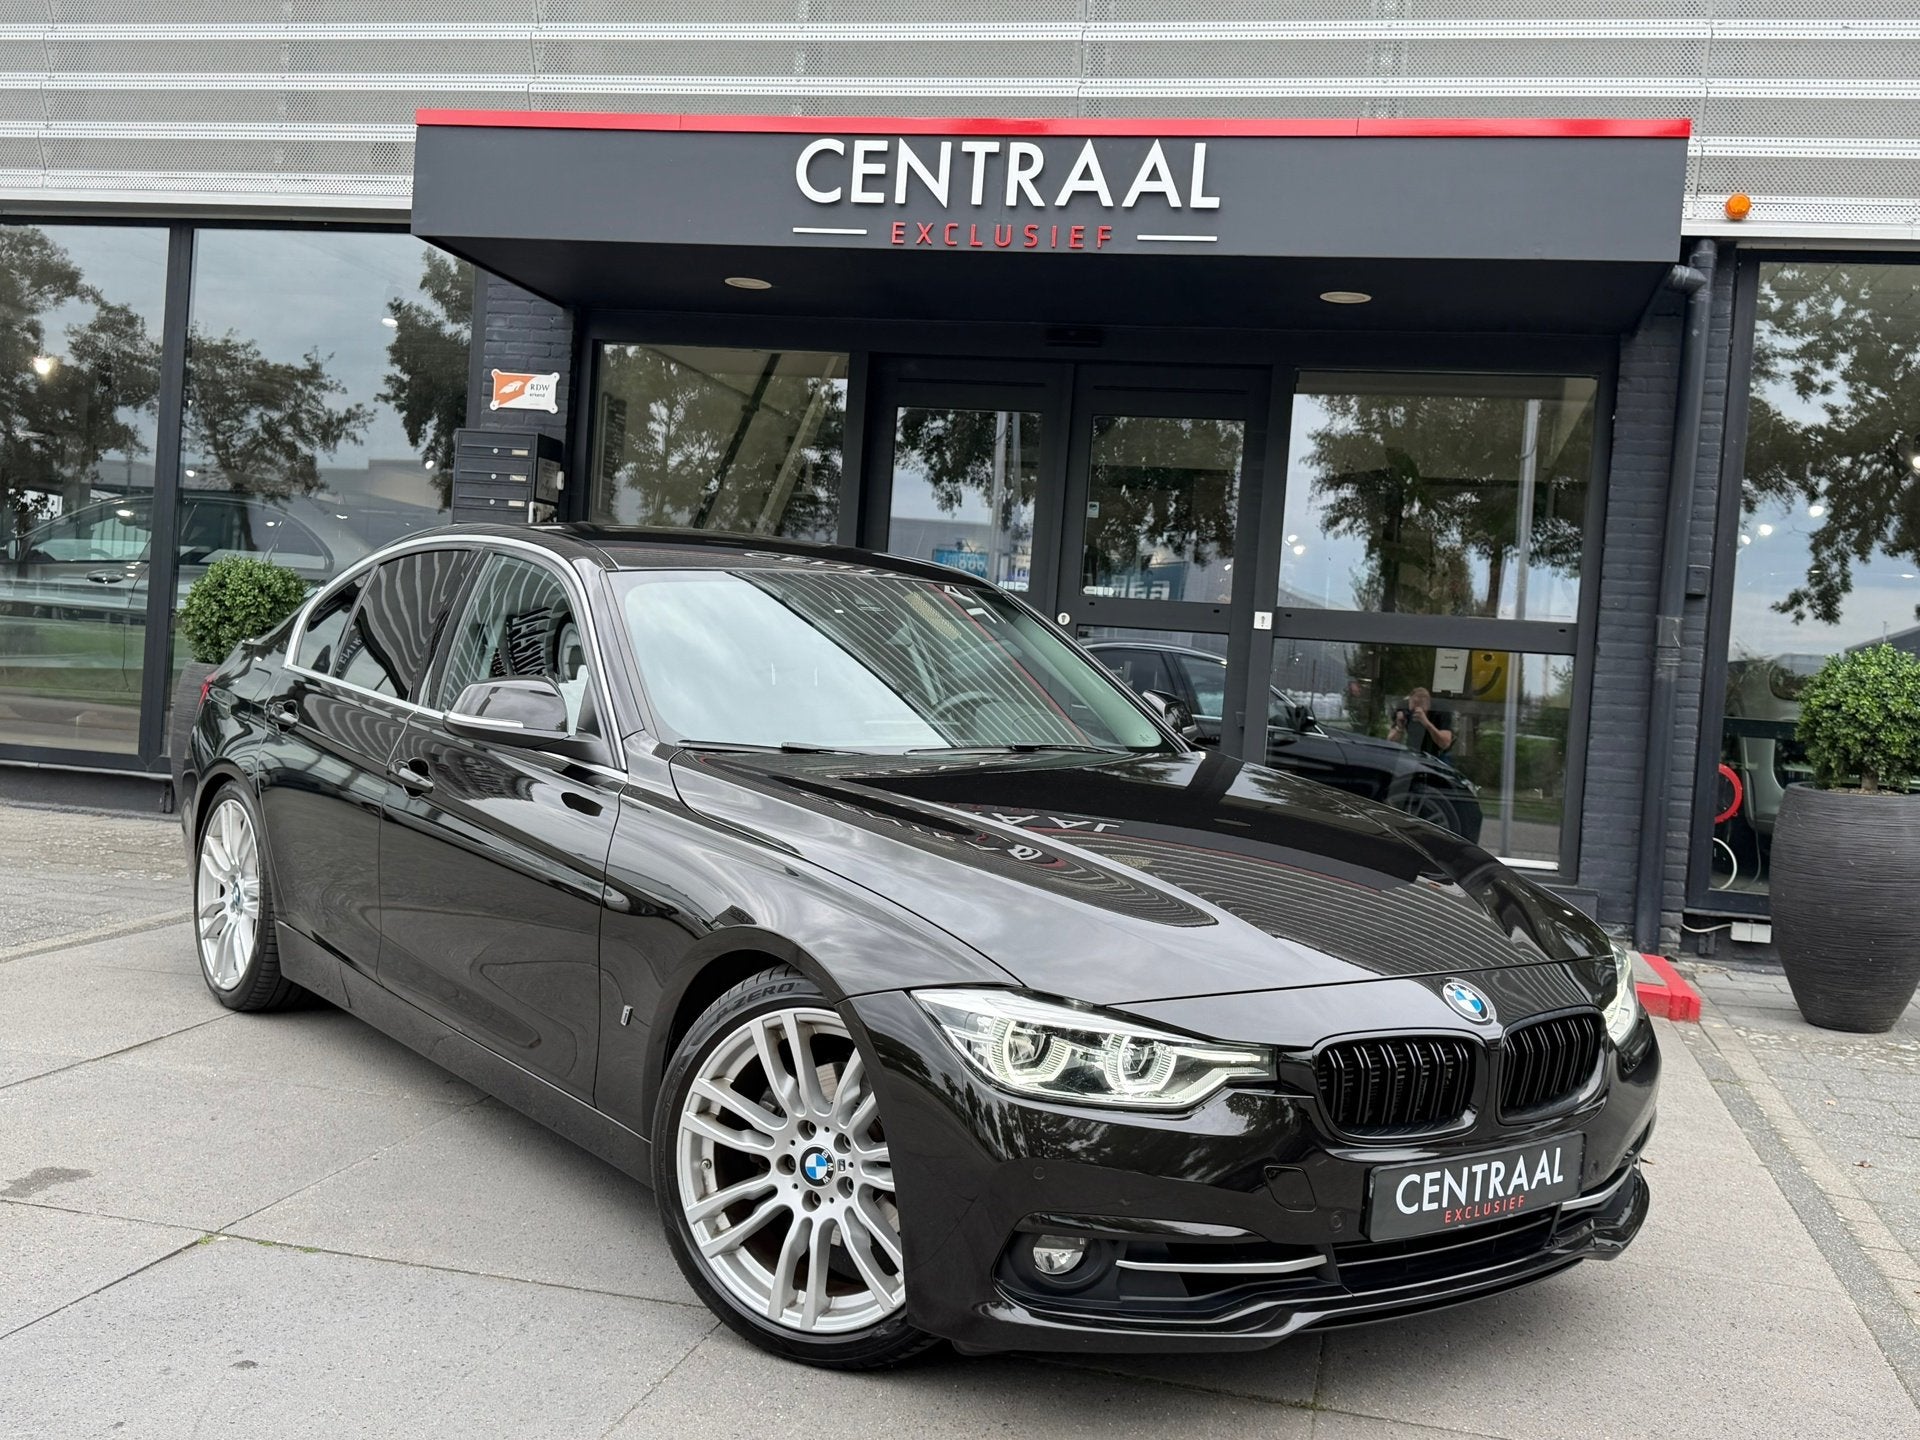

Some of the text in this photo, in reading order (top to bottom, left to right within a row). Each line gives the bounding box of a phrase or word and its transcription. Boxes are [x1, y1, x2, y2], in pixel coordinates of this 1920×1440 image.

[796, 137, 1220, 209] CENTRAAL
[891, 222, 1112, 249] EXCLUSIEF
[530, 383, 550, 391] RDW
[1395, 1147, 1564, 1215] CENTRAAL
[1444, 1195, 1525, 1224] EXCLUSIEF
